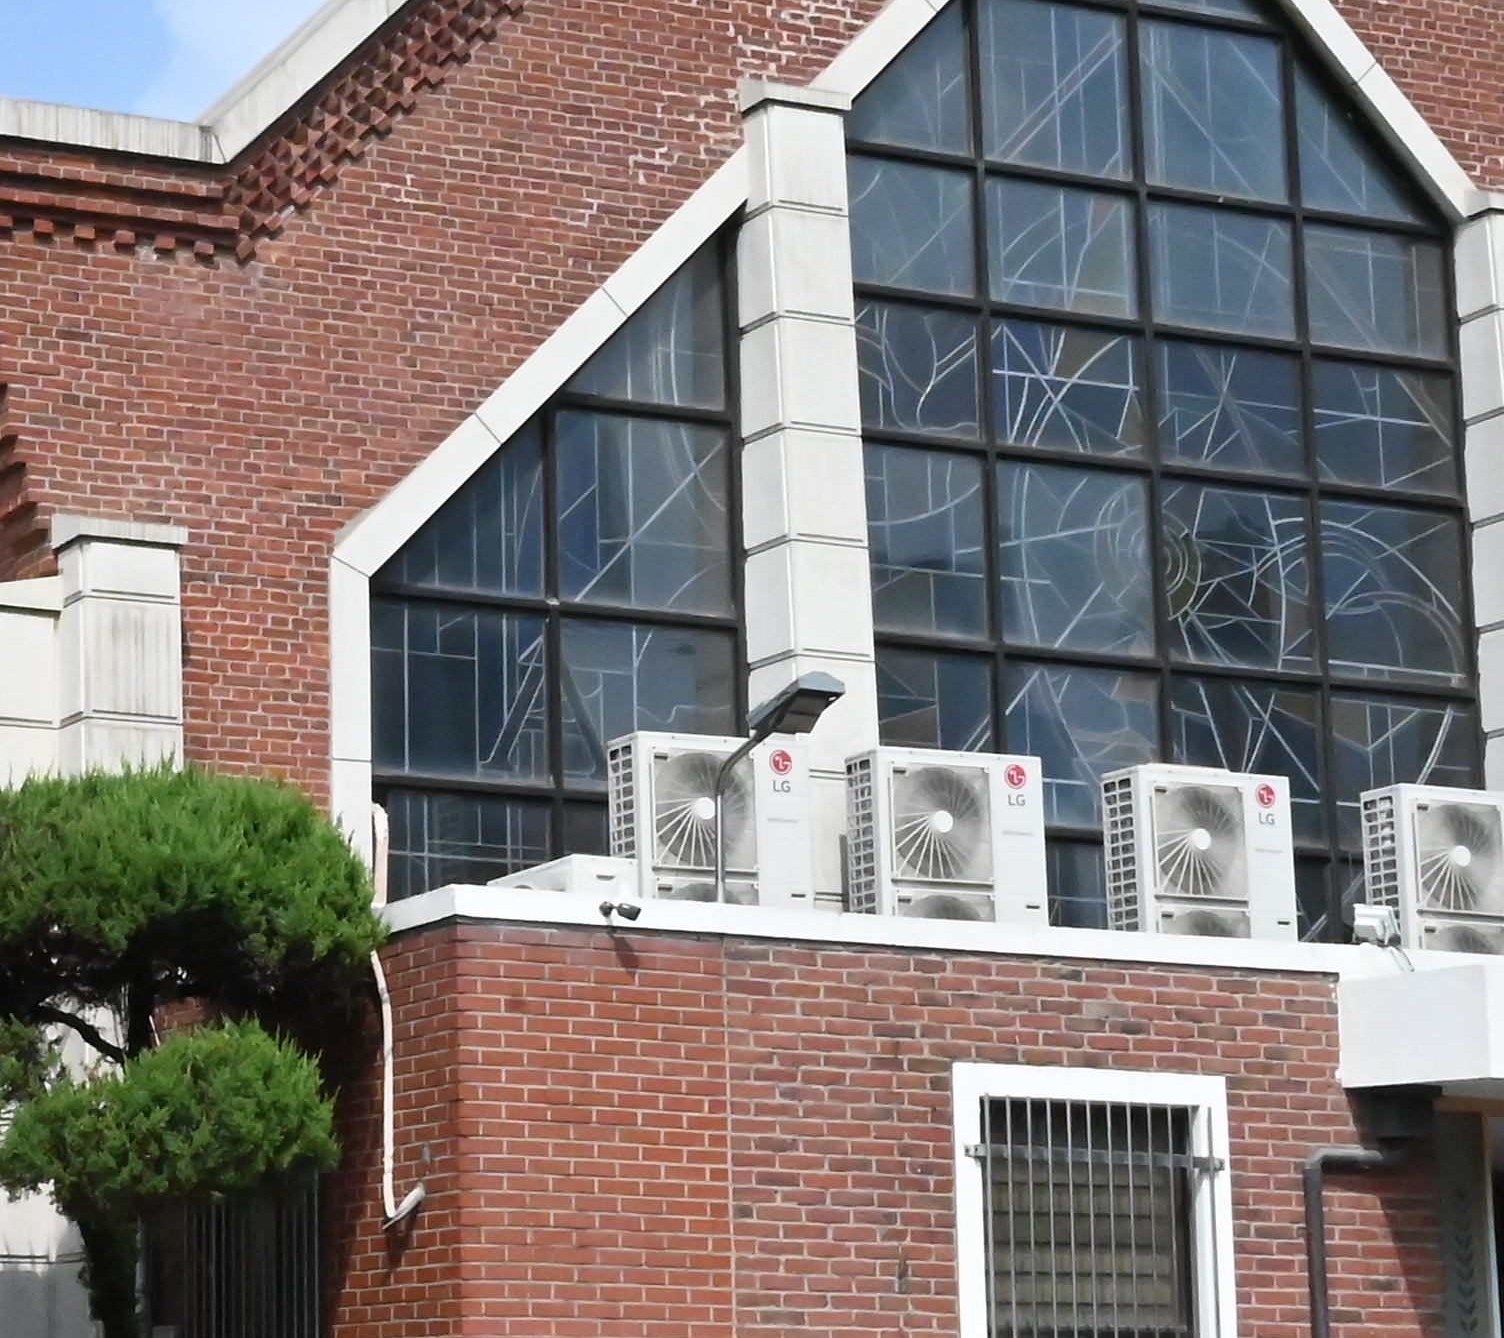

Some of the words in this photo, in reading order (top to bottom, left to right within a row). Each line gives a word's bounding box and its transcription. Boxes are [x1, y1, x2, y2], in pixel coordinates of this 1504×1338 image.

[772, 779, 791, 793] LG
[1008, 794, 1026, 807] LG
[1258, 812, 1276, 826] LG
